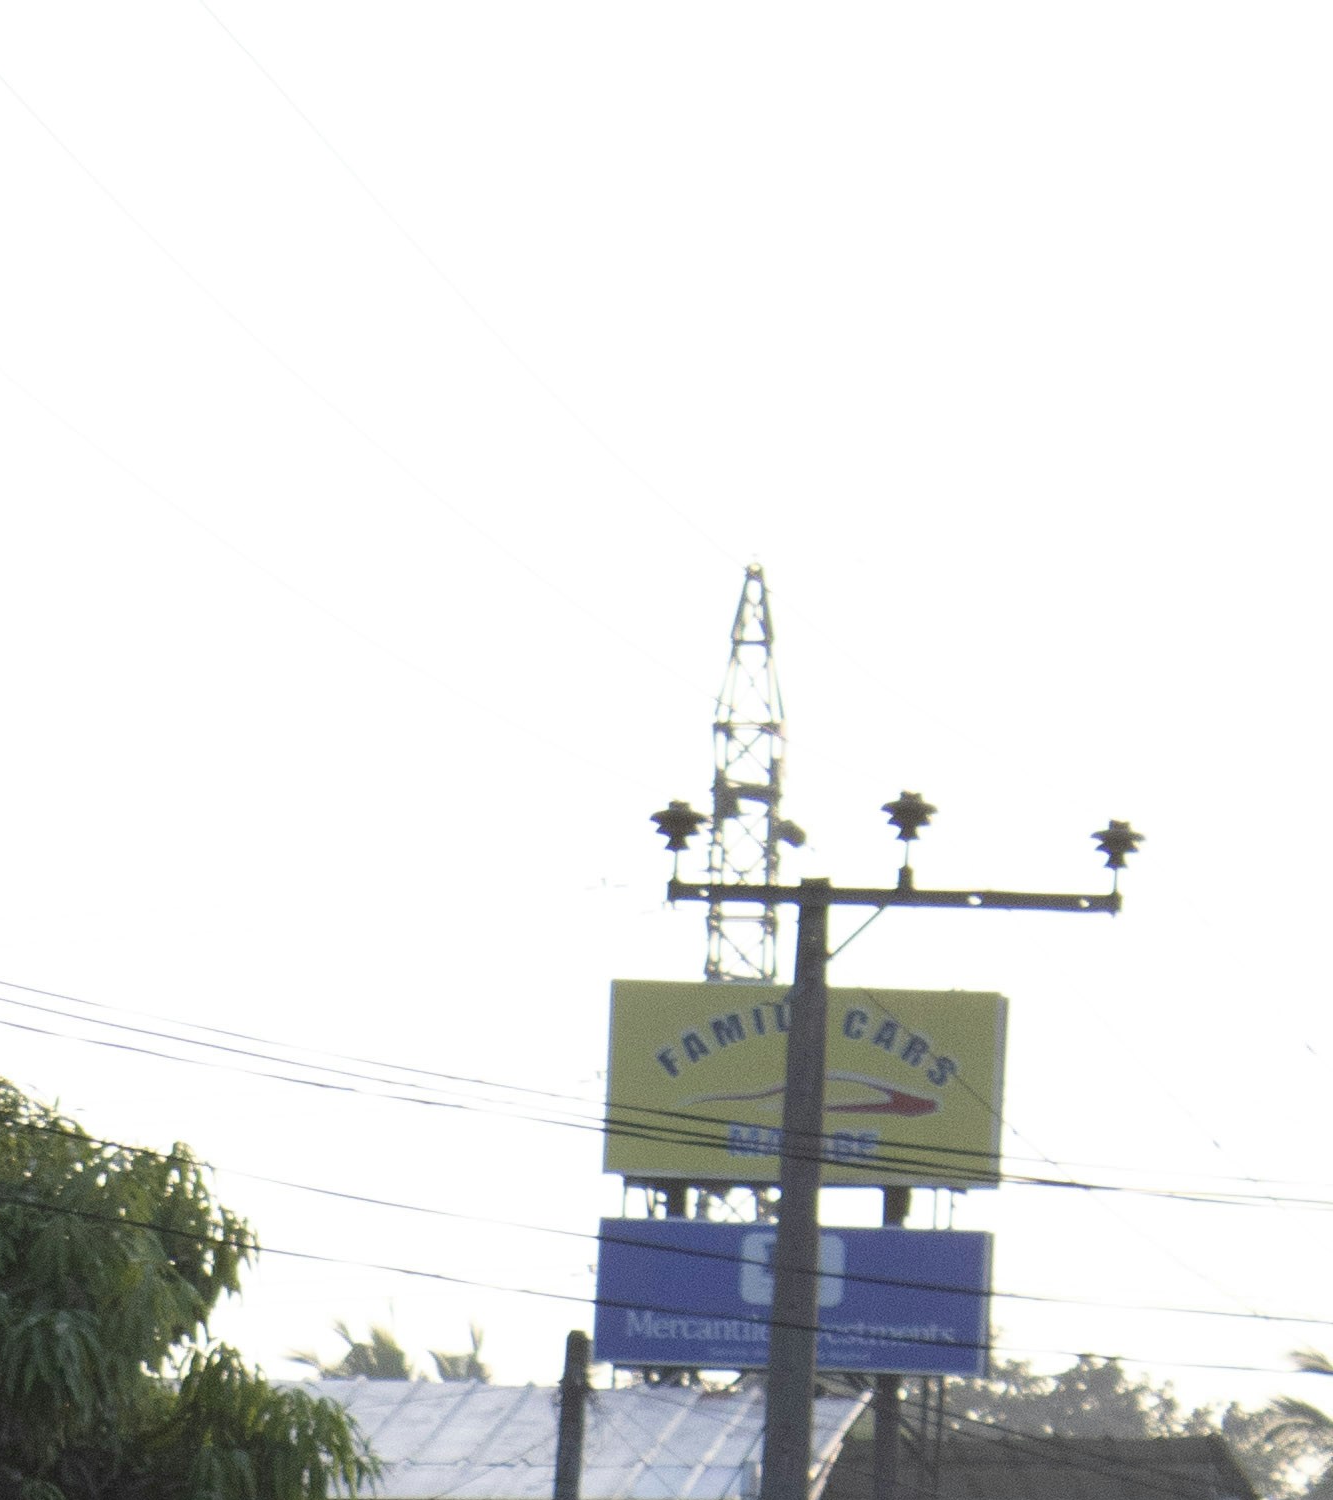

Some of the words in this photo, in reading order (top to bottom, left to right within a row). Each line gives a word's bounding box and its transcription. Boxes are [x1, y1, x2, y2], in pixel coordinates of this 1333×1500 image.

[656, 1003, 792, 1078] FAMIL
[843, 1009, 958, 1087] CARS
[624, 1309, 770, 1343] Mercantile
[818, 1321, 957, 1349] estments
